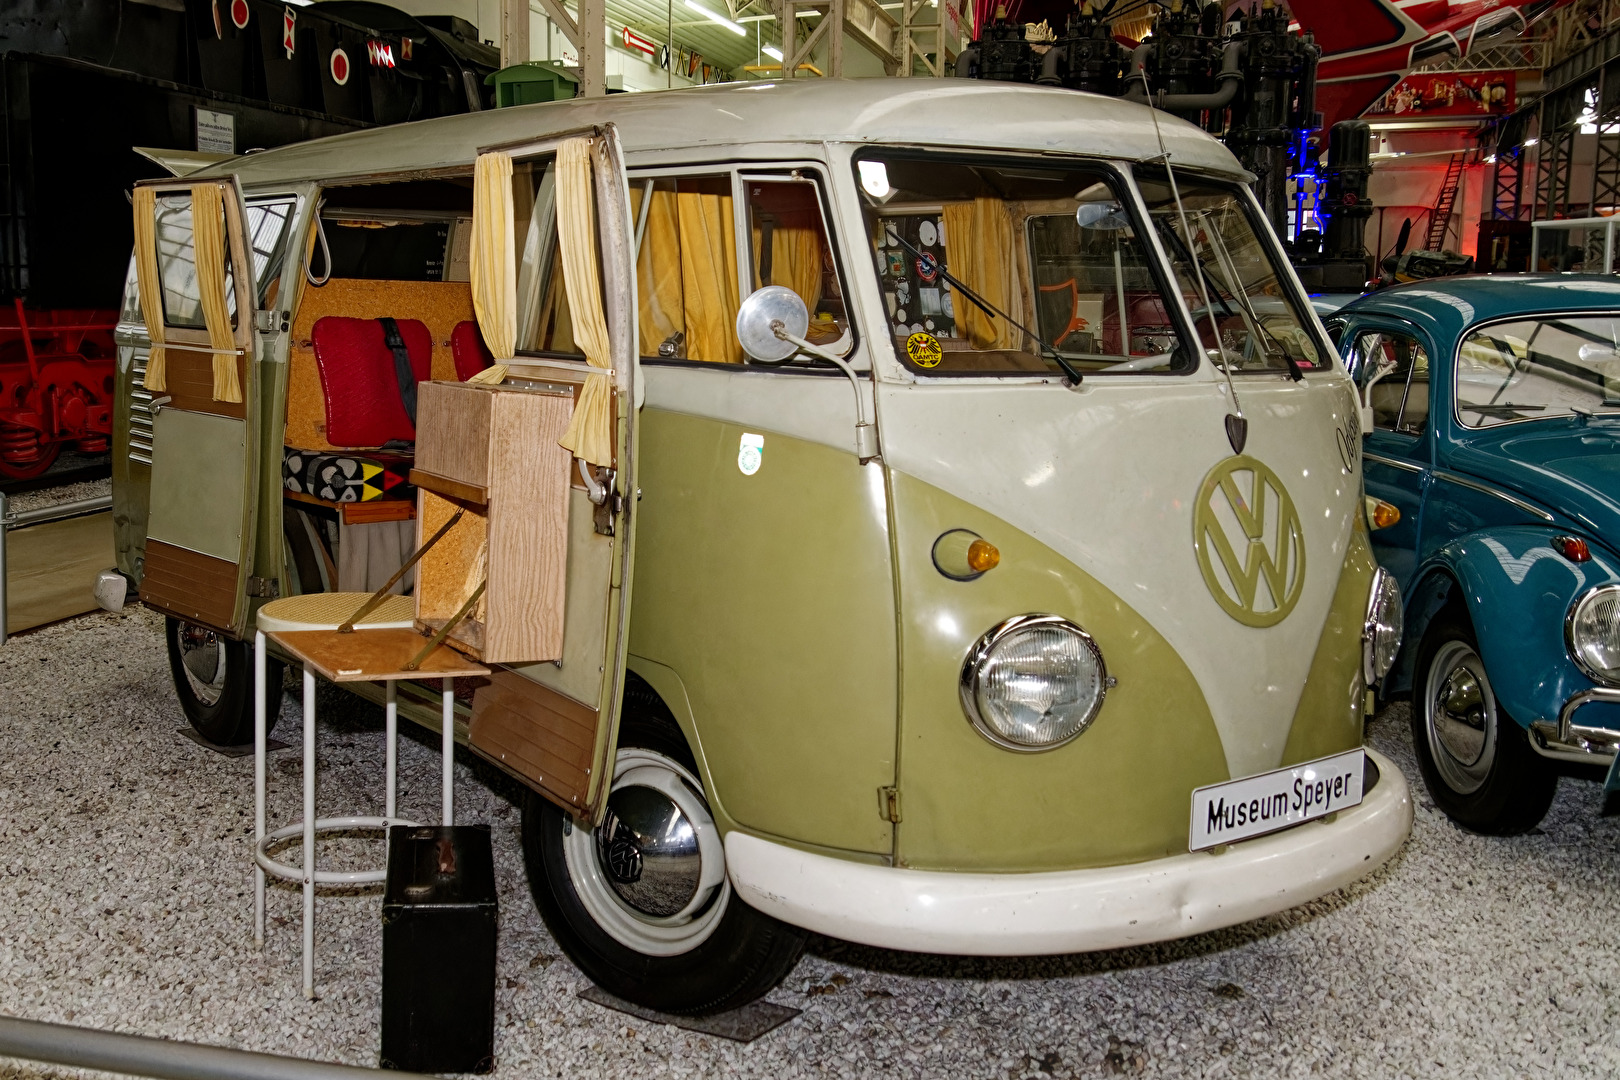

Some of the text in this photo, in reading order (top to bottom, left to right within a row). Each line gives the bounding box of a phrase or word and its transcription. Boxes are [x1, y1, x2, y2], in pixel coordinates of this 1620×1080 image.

[1195, 456, 1305, 626] VW
[1207, 772, 1352, 834] Museum Speyer
